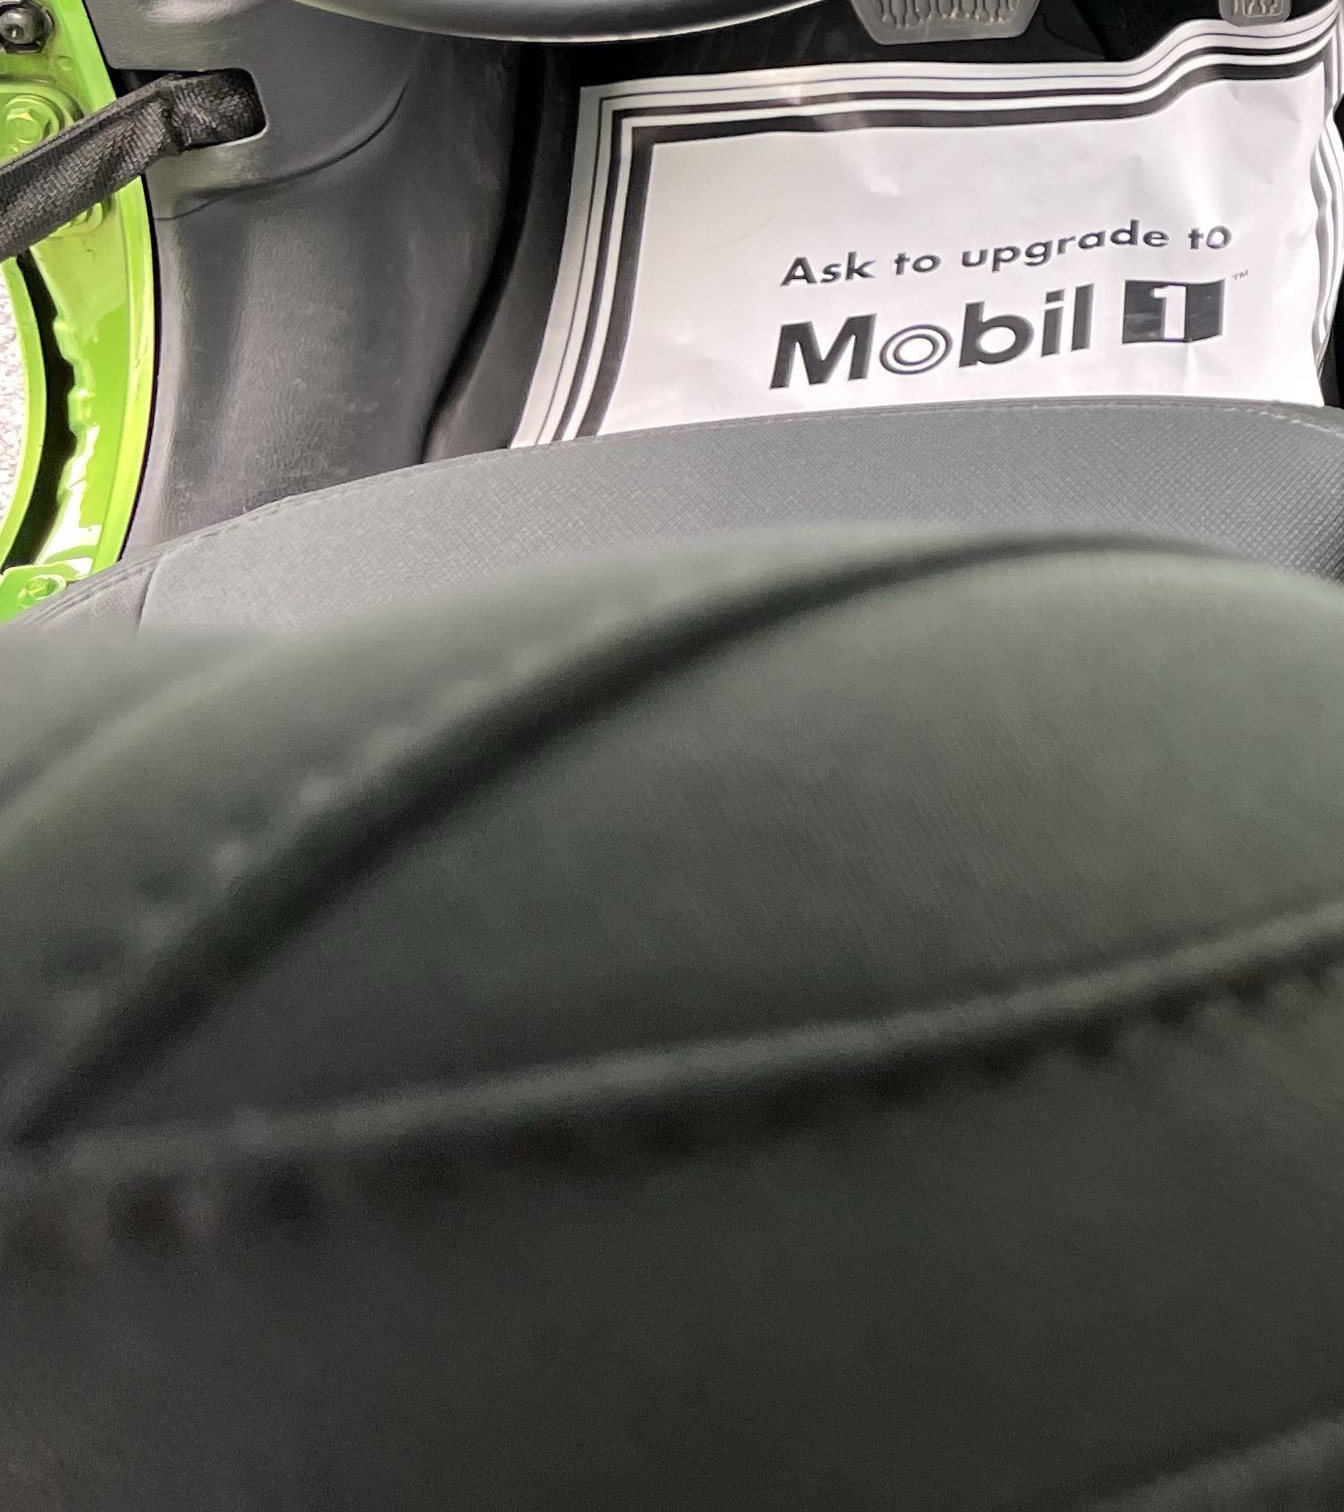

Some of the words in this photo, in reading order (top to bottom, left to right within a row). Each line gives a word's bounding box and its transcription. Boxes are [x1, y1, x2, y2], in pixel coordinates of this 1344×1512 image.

[780, 251, 877, 288] Ask
[894, 252, 942, 276] to
[961, 219, 1170, 274] upgrade
[1187, 224, 1233, 251] to
[769, 282, 1096, 390] Mobil
